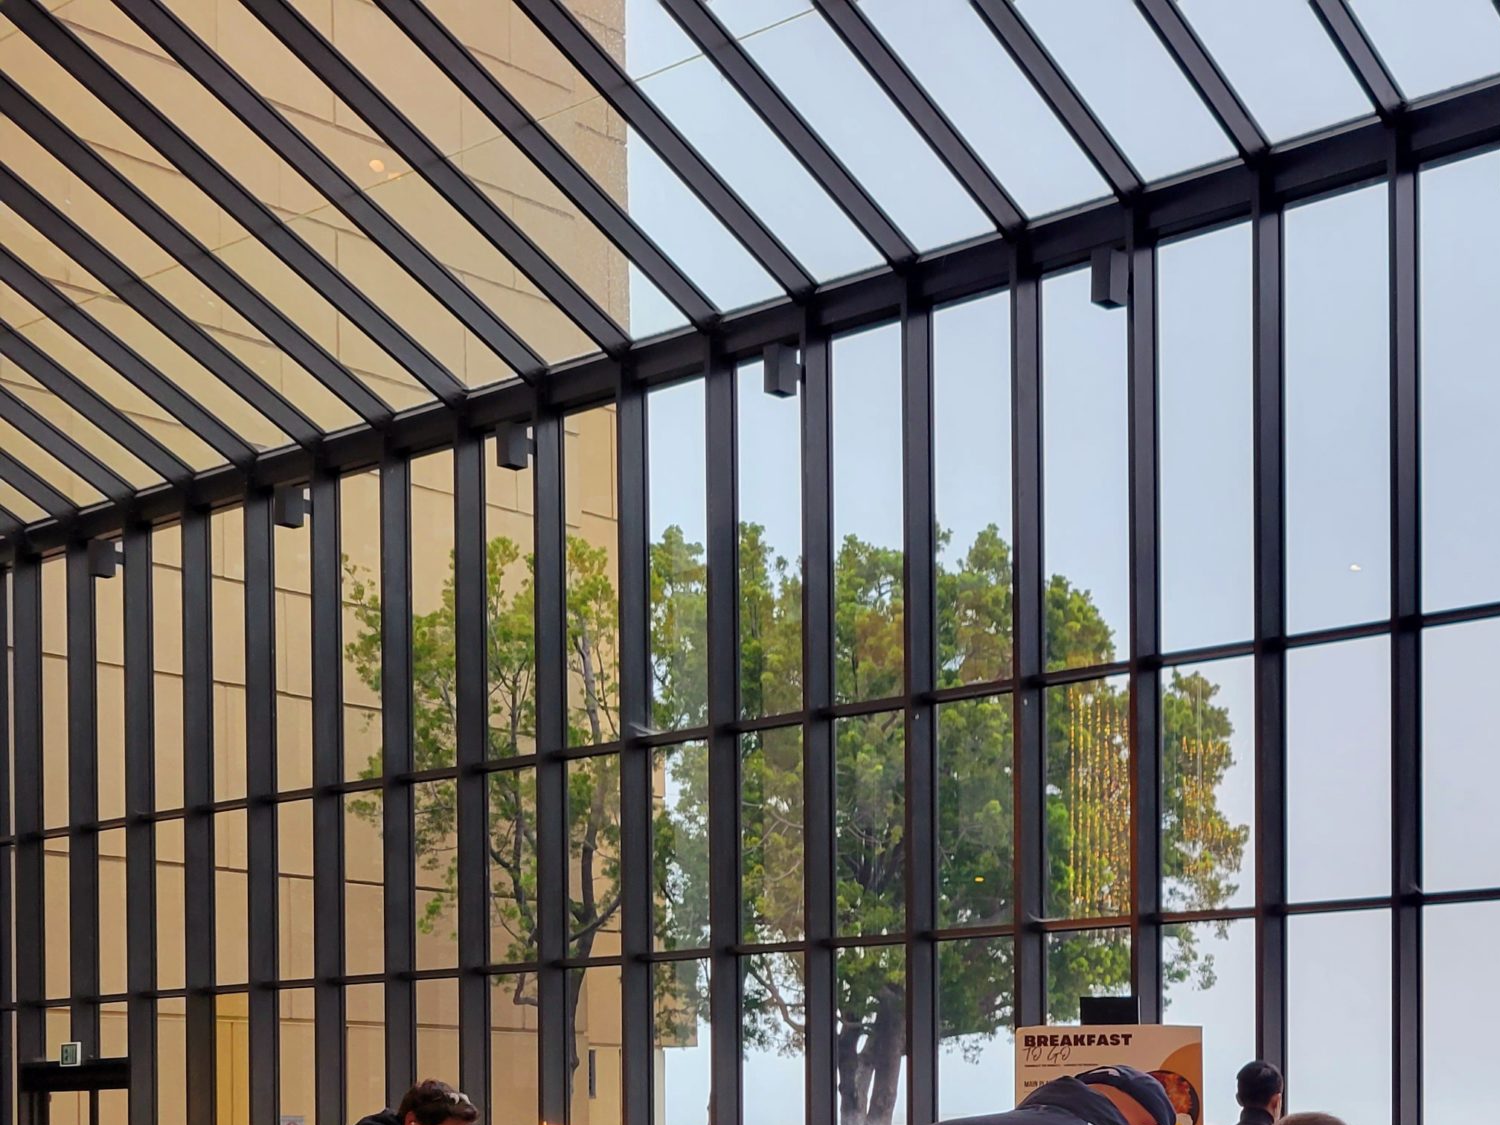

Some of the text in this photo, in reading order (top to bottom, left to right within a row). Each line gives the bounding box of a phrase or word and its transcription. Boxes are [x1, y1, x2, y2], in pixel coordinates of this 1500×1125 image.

[1024, 1034, 1132, 1047] BREAKFAST
[1022, 1046, 1071, 1063] TO GO
